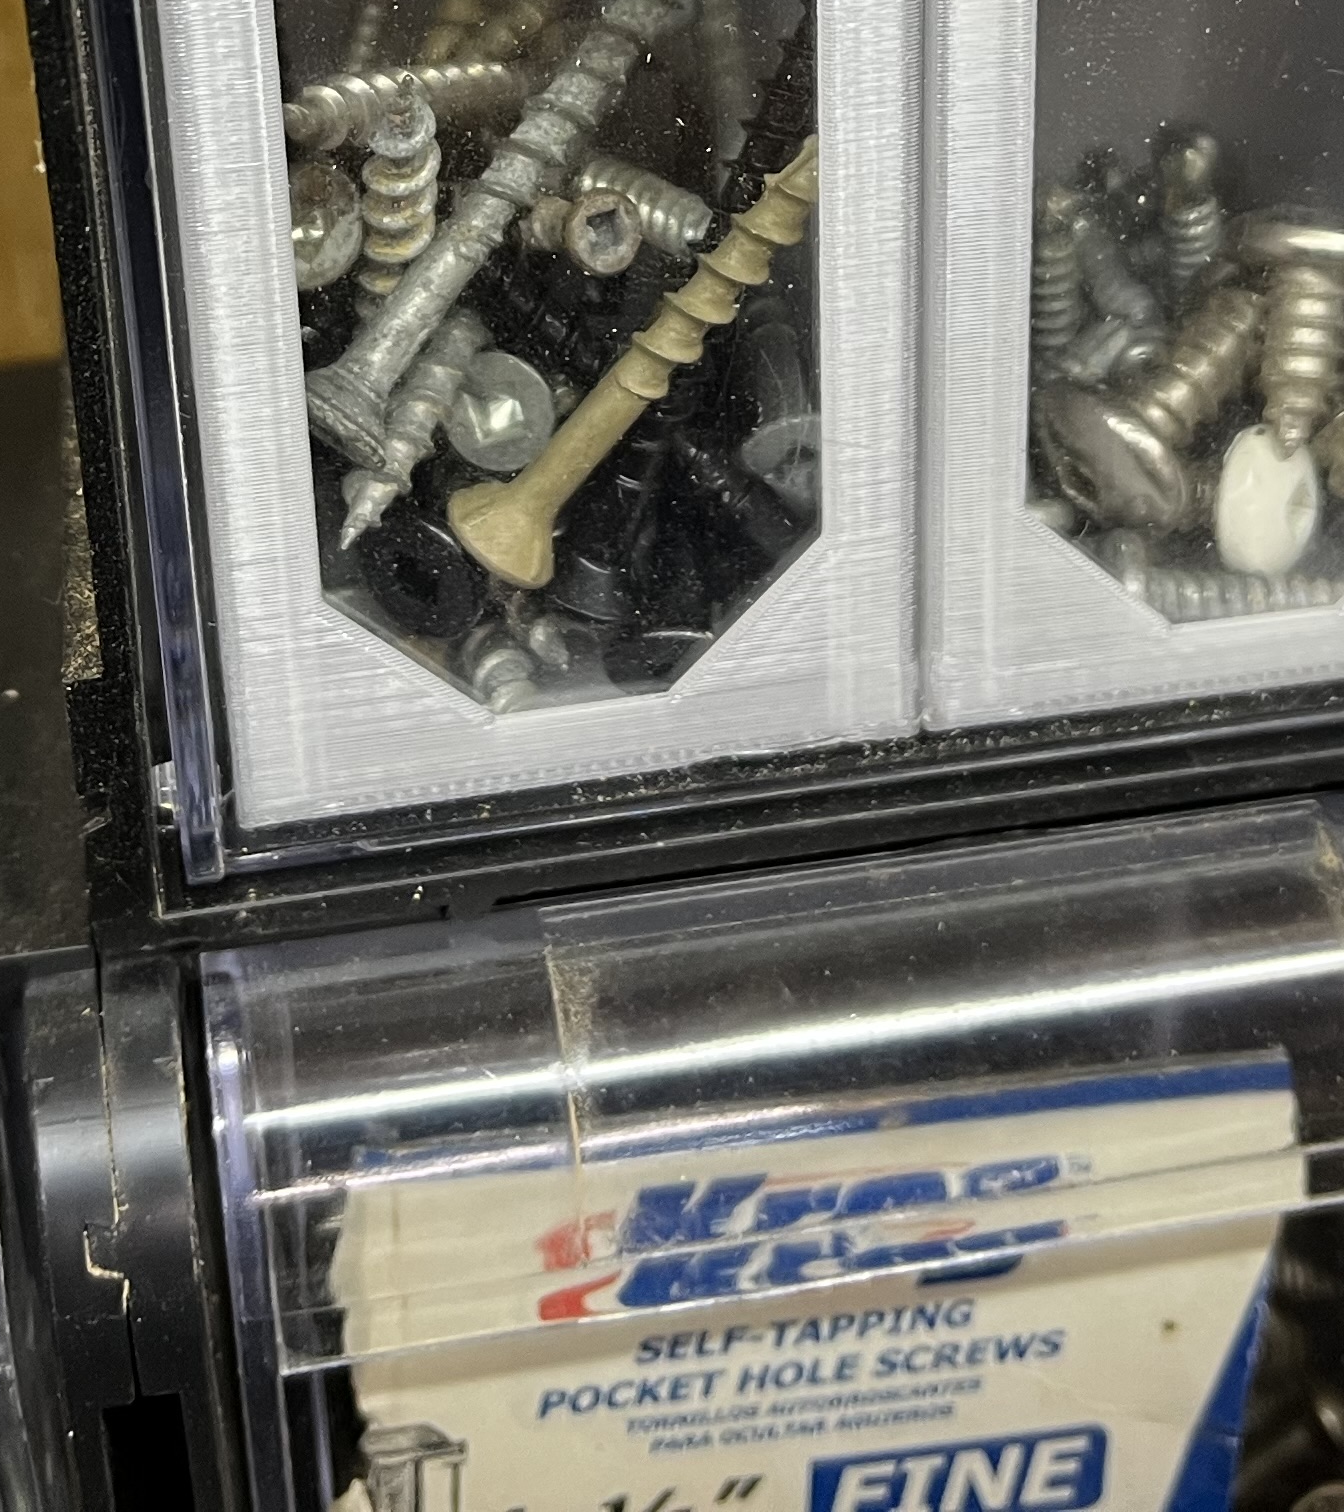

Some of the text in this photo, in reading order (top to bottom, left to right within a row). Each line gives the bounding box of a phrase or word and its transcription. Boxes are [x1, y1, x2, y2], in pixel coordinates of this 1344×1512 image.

[634, 1297, 977, 1365] SELF-TAPPING
[536, 1329, 1067, 1421] POCKET HOLE SCREWS
[827, 1435, 1090, 1512] FINE
